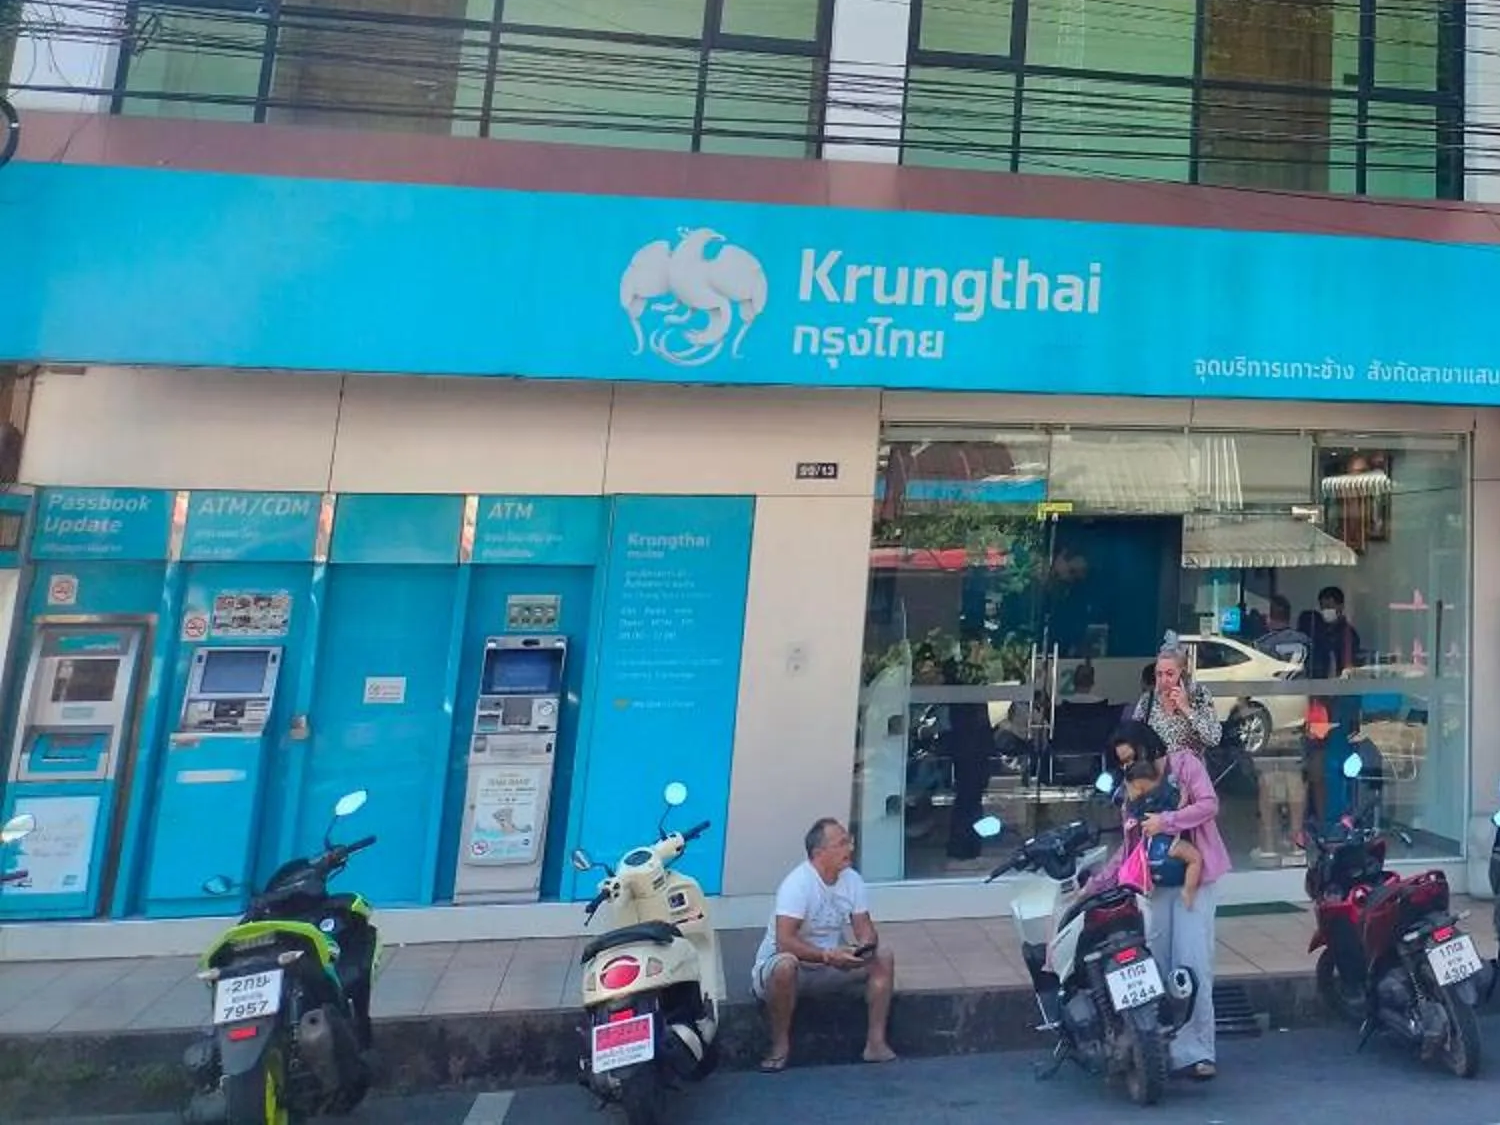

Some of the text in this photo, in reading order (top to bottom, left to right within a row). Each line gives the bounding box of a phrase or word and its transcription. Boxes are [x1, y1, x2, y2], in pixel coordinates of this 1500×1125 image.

[799, 247, 1102, 322] Krungthai
[792, 316, 945, 369] กรุงไทย
[1194, 355, 1355, 385] จุดบริการเกาะช้าง
[49, 494, 152, 512] Passbook
[198, 496, 311, 516] ATM/CDM
[487, 502, 535, 520] ATM
[44, 516, 123, 536] Update
[1121, 985, 1157, 1006] 4244
[223, 1000, 269, 1020] 7957
